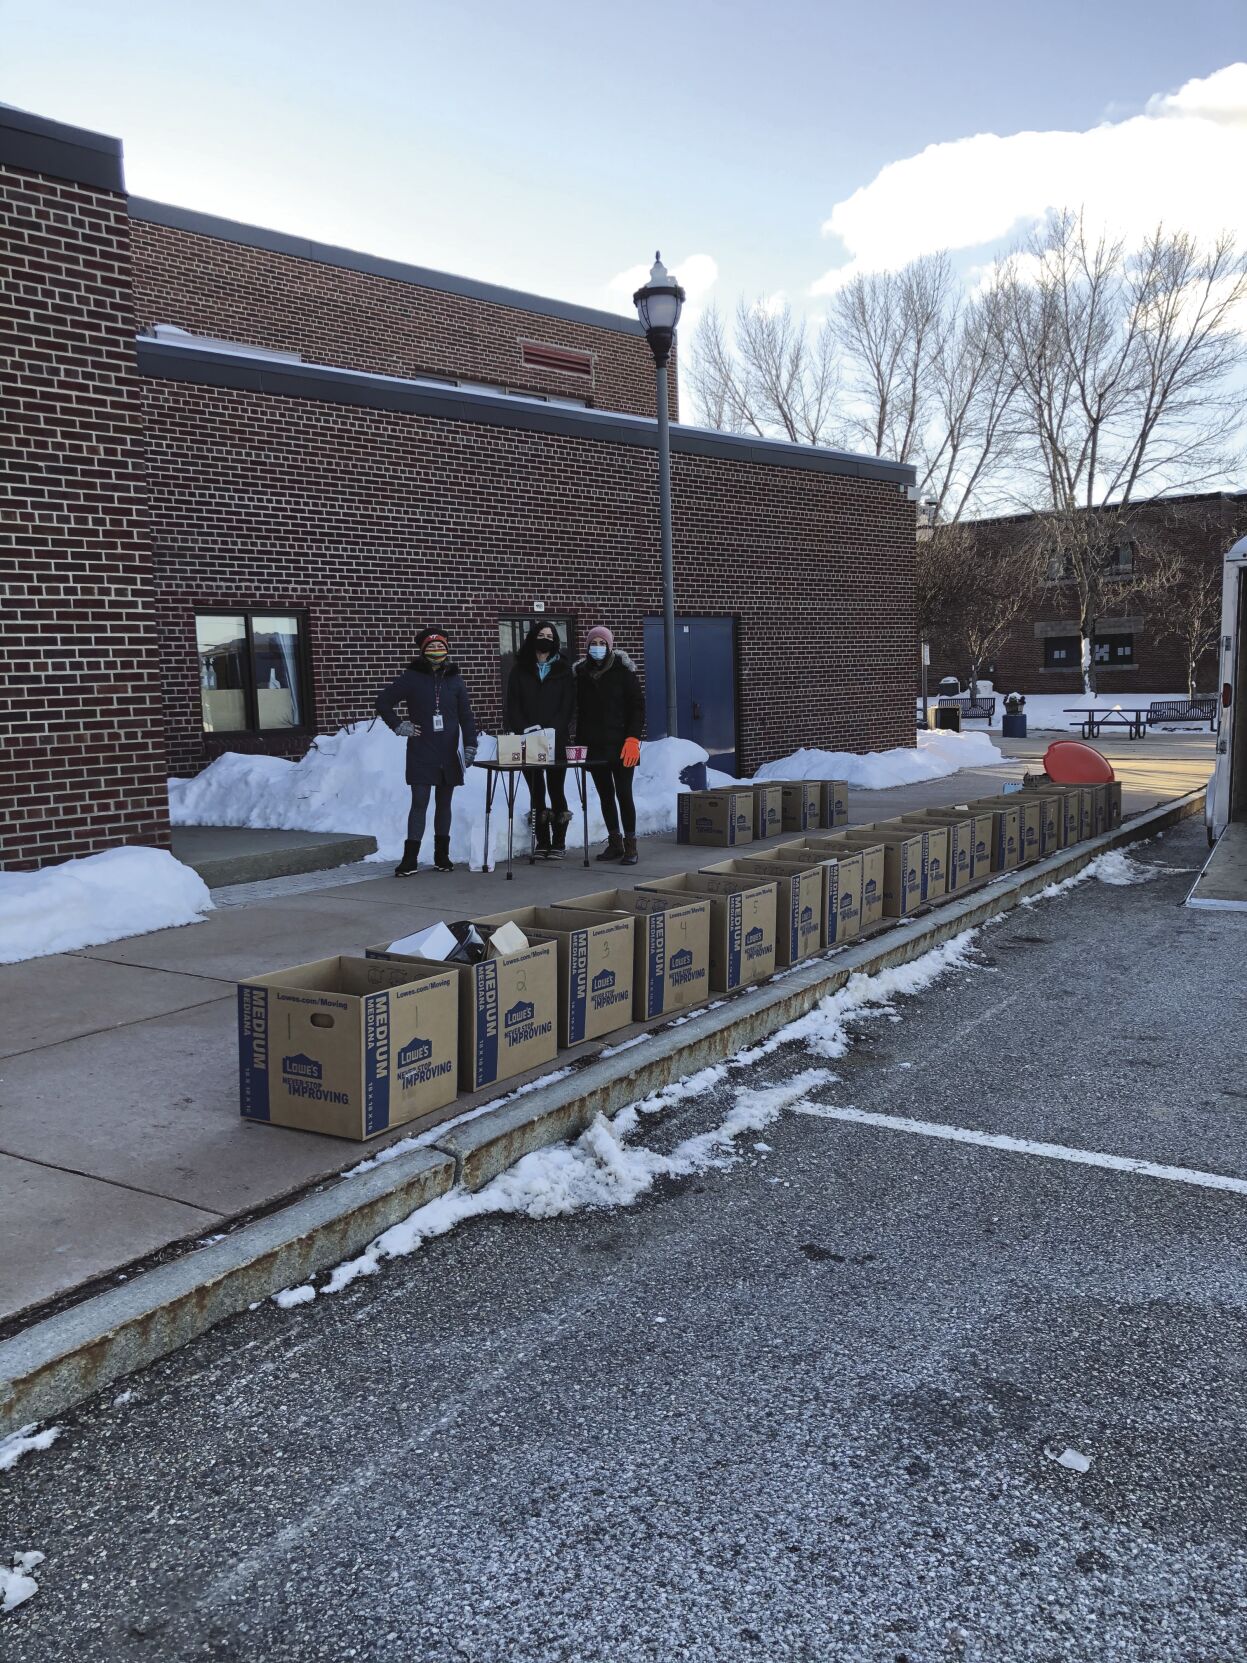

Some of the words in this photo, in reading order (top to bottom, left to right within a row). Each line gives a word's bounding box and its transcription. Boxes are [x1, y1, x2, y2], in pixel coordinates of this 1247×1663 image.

[680, 921, 687, 938] 4
[734, 896, 742, 952] MEDIUM
[601, 940, 610, 960] 3
[655, 915, 664, 977] MEDIUM
[503, 947, 550, 966] Lowes.com/Moving
[577, 933, 587, 999] MEDIUM
[671, 954, 691, 968] LOWE'S
[516, 969, 528, 992] 2
[593, 975, 614, 990] LOWE'S
[671, 968, 706, 988] IMPROVING
[396, 978, 451, 999] Lowes.com/Moving
[276, 992, 348, 1010] Lowes.com/Moving
[485, 963, 497, 1037] MEDIUM
[593, 990, 629, 1010] IMPROVING
[243, 988, 252, 1036] MEDIANA
[507, 1007, 532, 1025] LOWE'S
[252, 990, 267, 1070] MEDIUM
[367, 999, 375, 1050] MEDIANA
[508, 1021, 552, 1048] IMPROVING
[376, 995, 388, 1079] MEDIUM
[400, 1045, 429, 1064] LOWE'S
[286, 1059, 319, 1077] LOWE'S
[402, 1061, 452, 1091] IMPROVING
[417, 1061, 432, 1072] STOP
[282, 1076, 304, 1086] NEVER
[304, 1080, 323, 1090] STOP
[287, 1082, 349, 1105] IMPROVING
